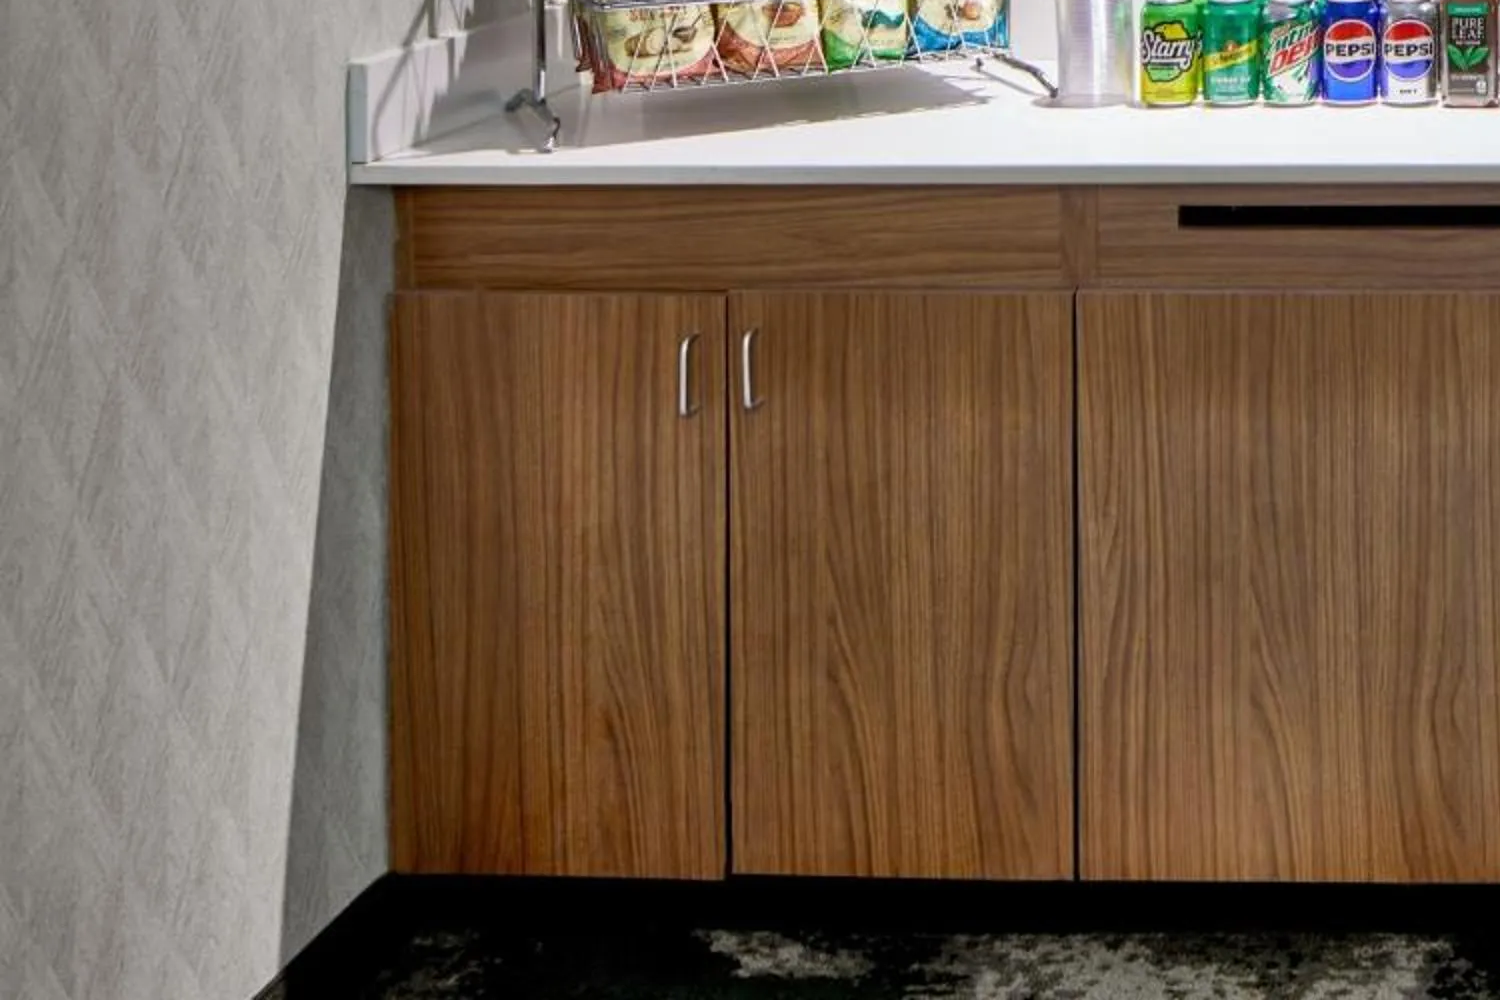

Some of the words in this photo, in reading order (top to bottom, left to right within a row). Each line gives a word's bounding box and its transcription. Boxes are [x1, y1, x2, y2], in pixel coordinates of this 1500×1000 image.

[1451, 17, 1485, 29] PURE
[1451, 29, 1484, 39] LEAF
[1141, 30, 1192, 71] Starry
[1326, 43, 1375, 57] PEPSI
[1384, 43, 1433, 57] PEPSI
